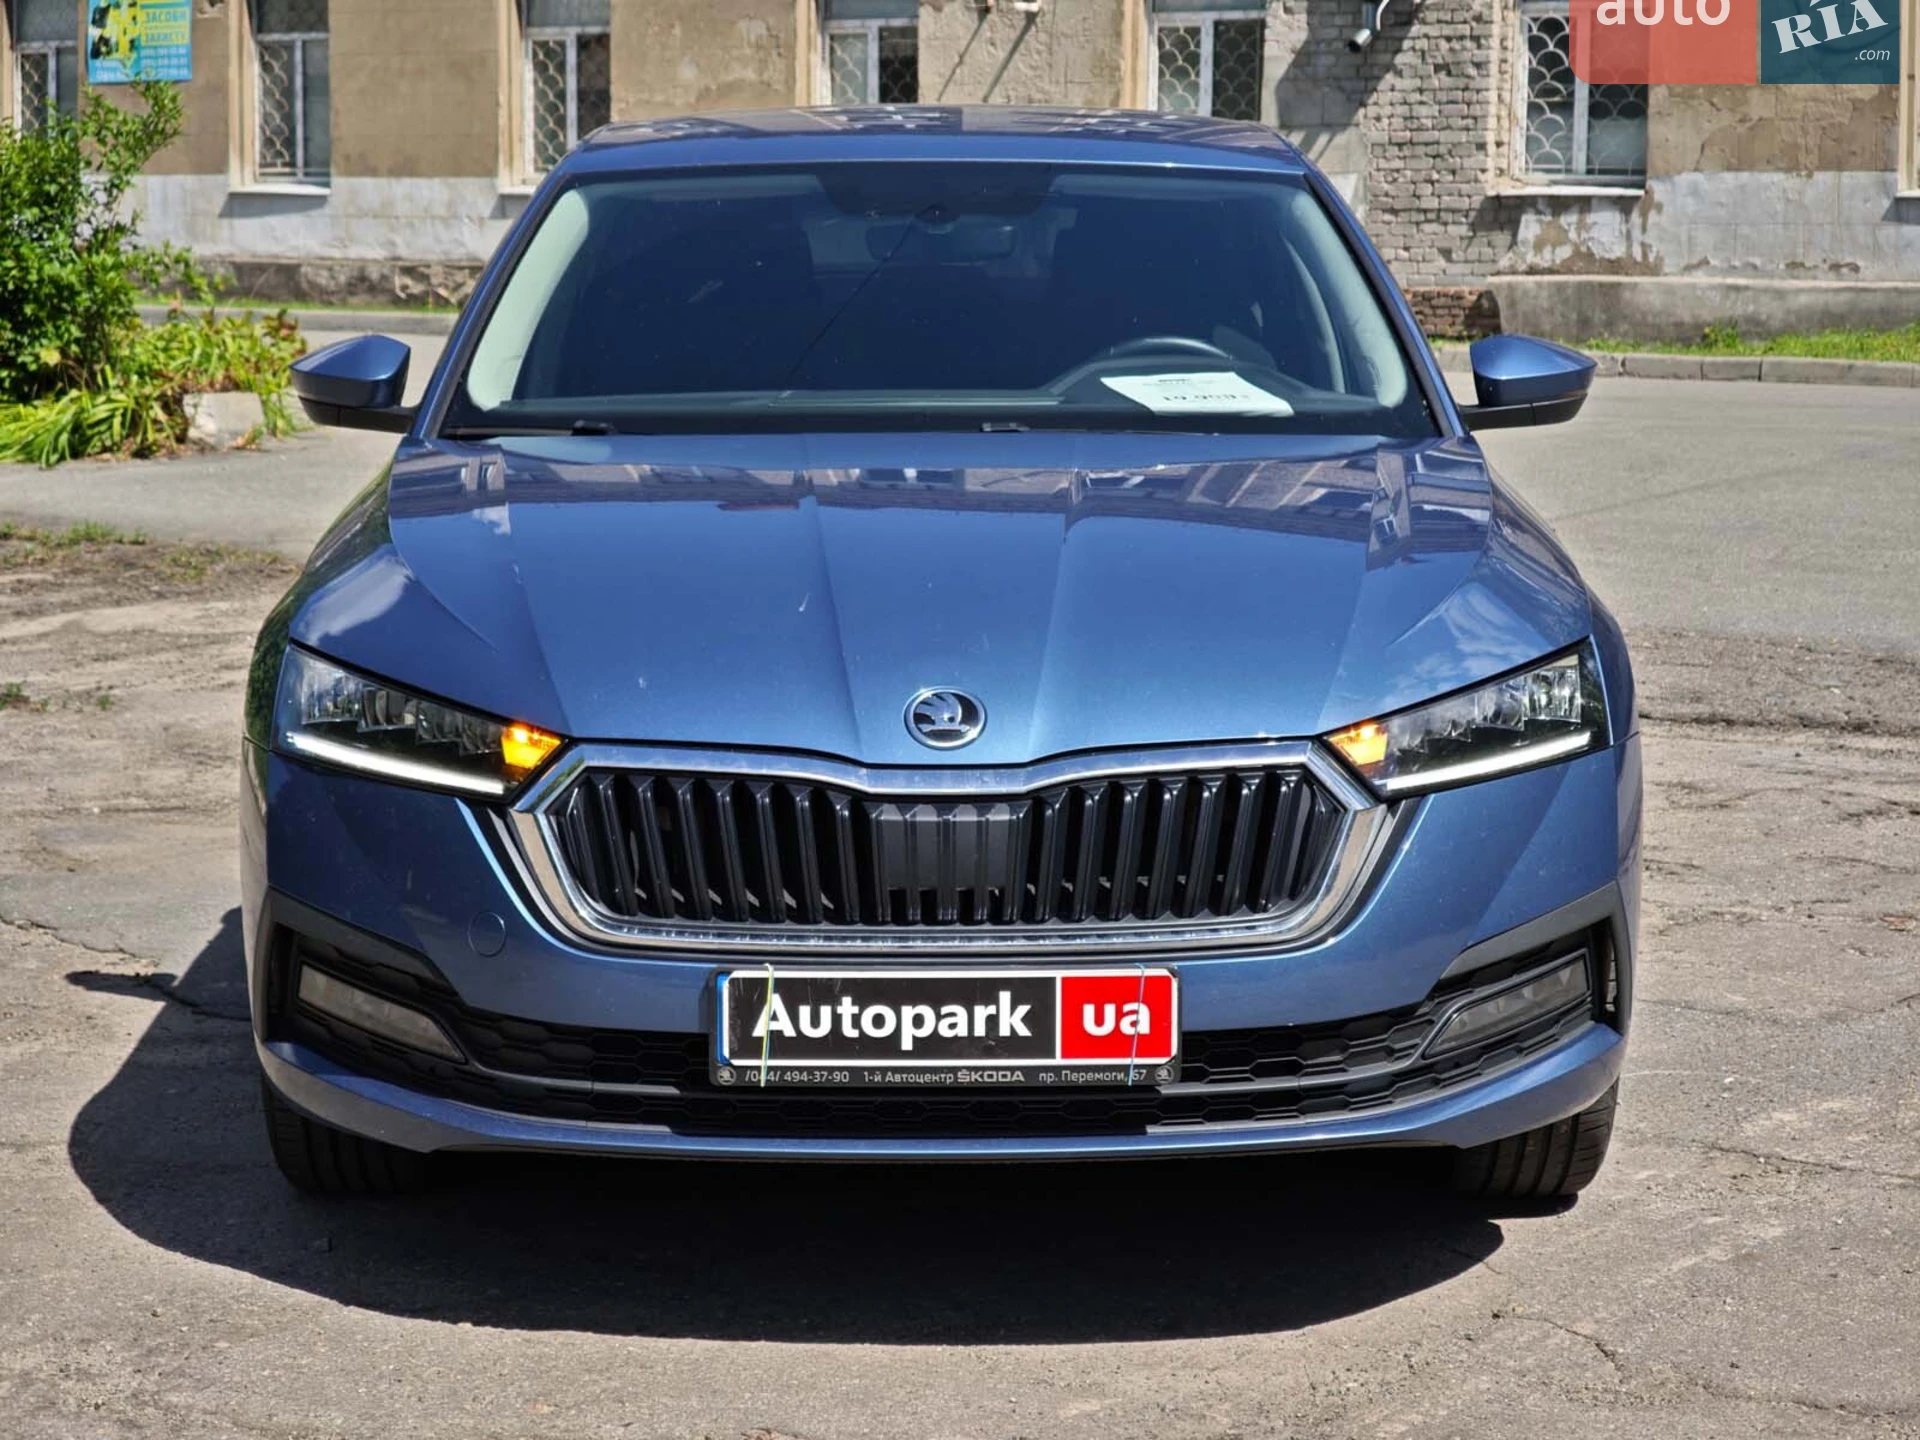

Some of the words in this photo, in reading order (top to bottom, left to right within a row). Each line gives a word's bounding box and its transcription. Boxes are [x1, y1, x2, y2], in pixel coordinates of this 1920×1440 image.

[752, 990, 1032, 1051] Autopark
[1083, 1002, 1151, 1036] ua
[745, 1069, 781, 1082] /04/
[784, 1070, 850, 1083] 494-37-90
[863, 1070, 881, 1082] 1-й
[885, 1070, 954, 1084] Автоцентр
[957, 1069, 1025, 1082] ŠKODA
[1039, 1073, 1058, 1084] пр.
